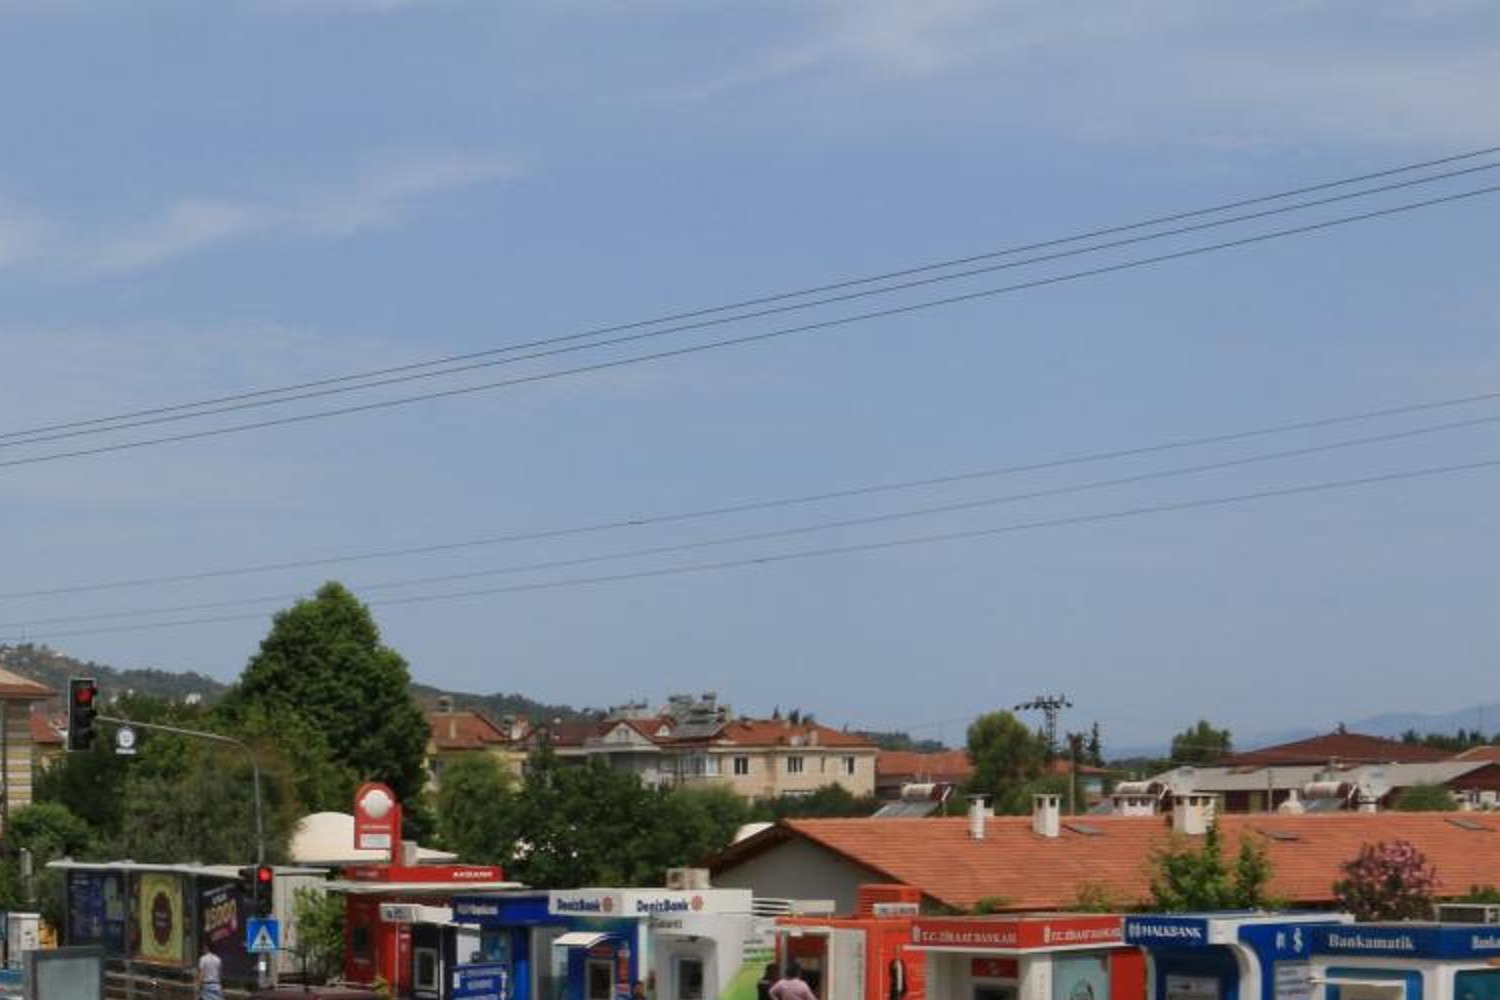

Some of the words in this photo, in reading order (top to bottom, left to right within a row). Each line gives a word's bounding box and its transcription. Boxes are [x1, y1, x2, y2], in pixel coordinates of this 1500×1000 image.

[557, 899, 601, 912] DenizBank
[636, 899, 689, 912] DenizBank
[1142, 925, 1202, 938] HALKBANK
[1329, 933, 1415, 950] Bankamatik
